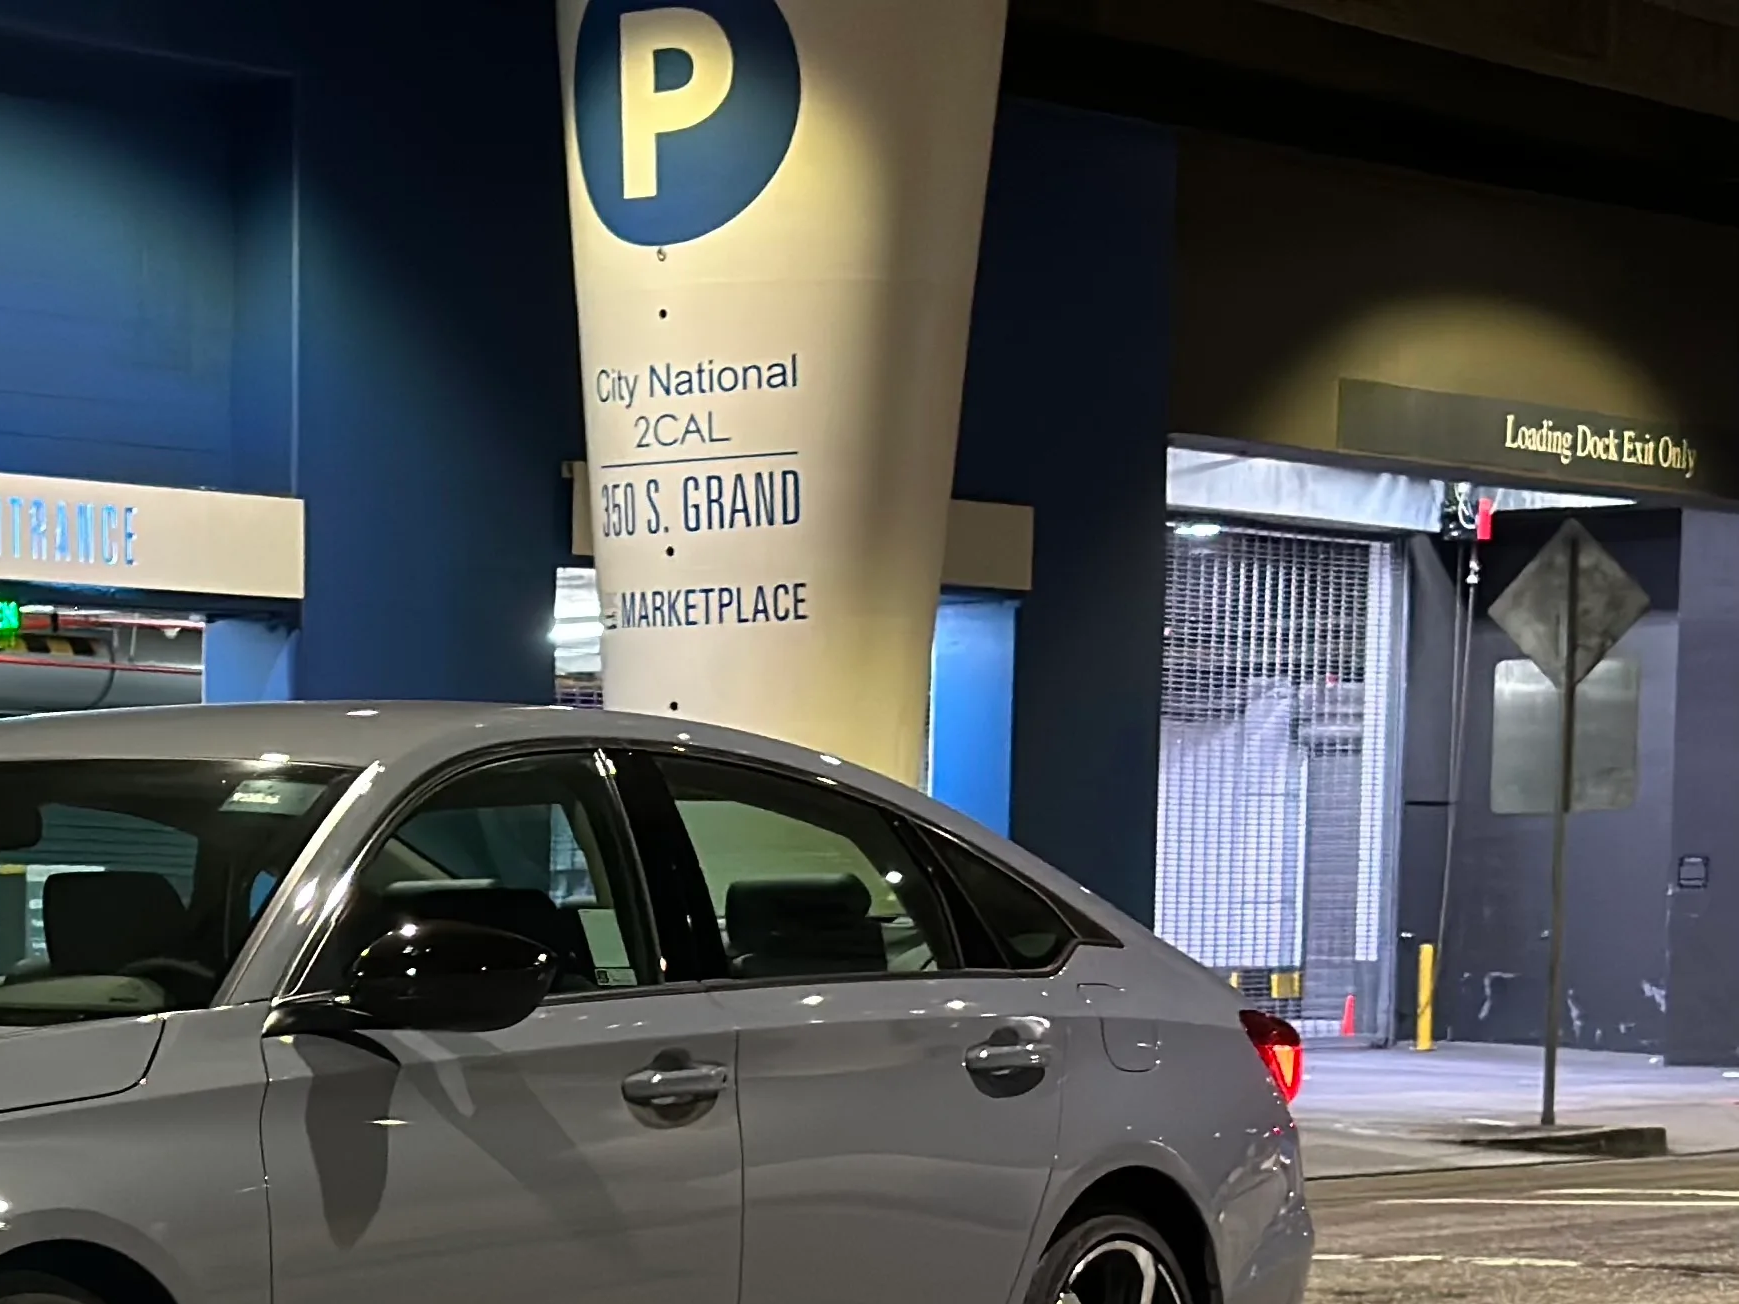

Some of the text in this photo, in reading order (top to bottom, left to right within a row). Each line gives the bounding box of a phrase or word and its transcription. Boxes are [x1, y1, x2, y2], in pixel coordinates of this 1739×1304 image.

[619, 7, 734, 200] P
[596, 353, 798, 409] City National
[634, 411, 732, 448] 2CAL
[1504, 413, 1697, 479] Loading Dock Exit Only
[602, 470, 800, 537] 350 S. GRAND
[621, 583, 810, 629] MARKETPLACE
